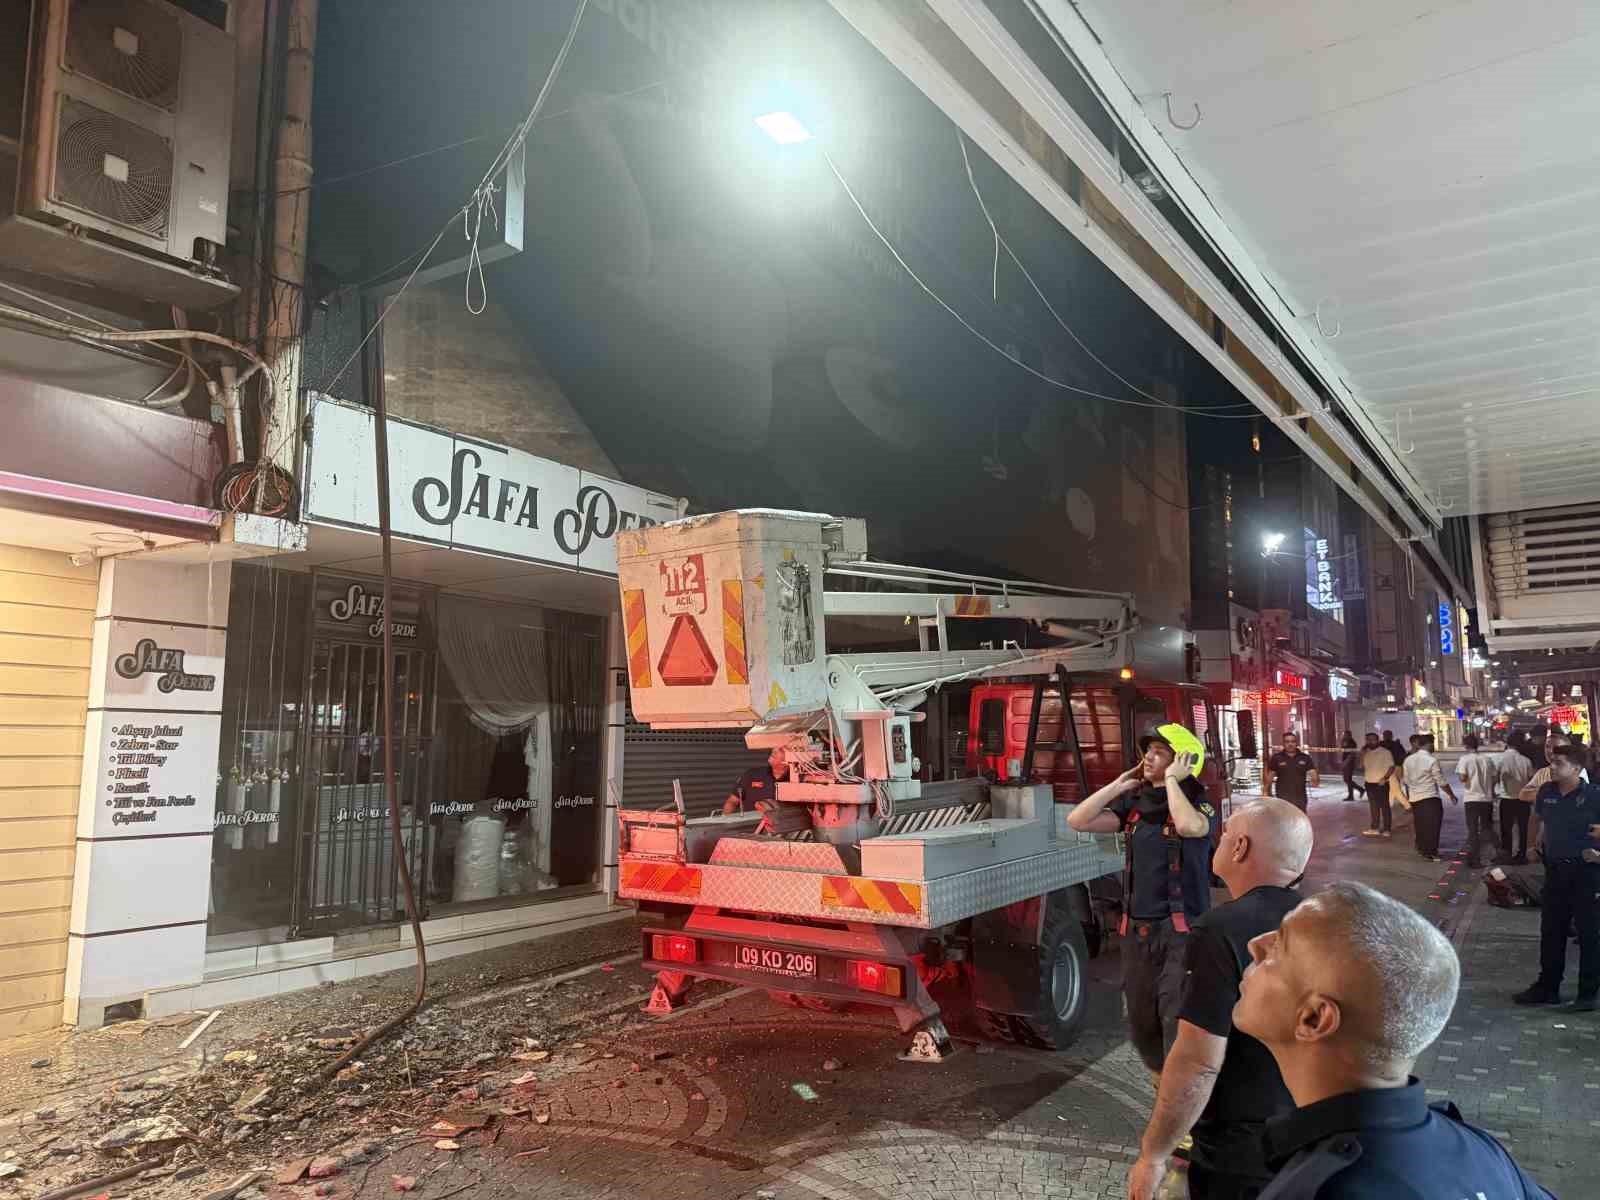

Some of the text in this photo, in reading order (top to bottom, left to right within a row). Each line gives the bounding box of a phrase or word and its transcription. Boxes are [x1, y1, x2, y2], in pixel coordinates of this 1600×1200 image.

[411, 448, 540, 530] SAFA
[665, 561, 699, 592] 112
[115, 638, 186, 680] SAFA
[742, 947, 759, 965] 09
[762, 950, 782, 968] KD
[786, 953, 814, 972] 206
